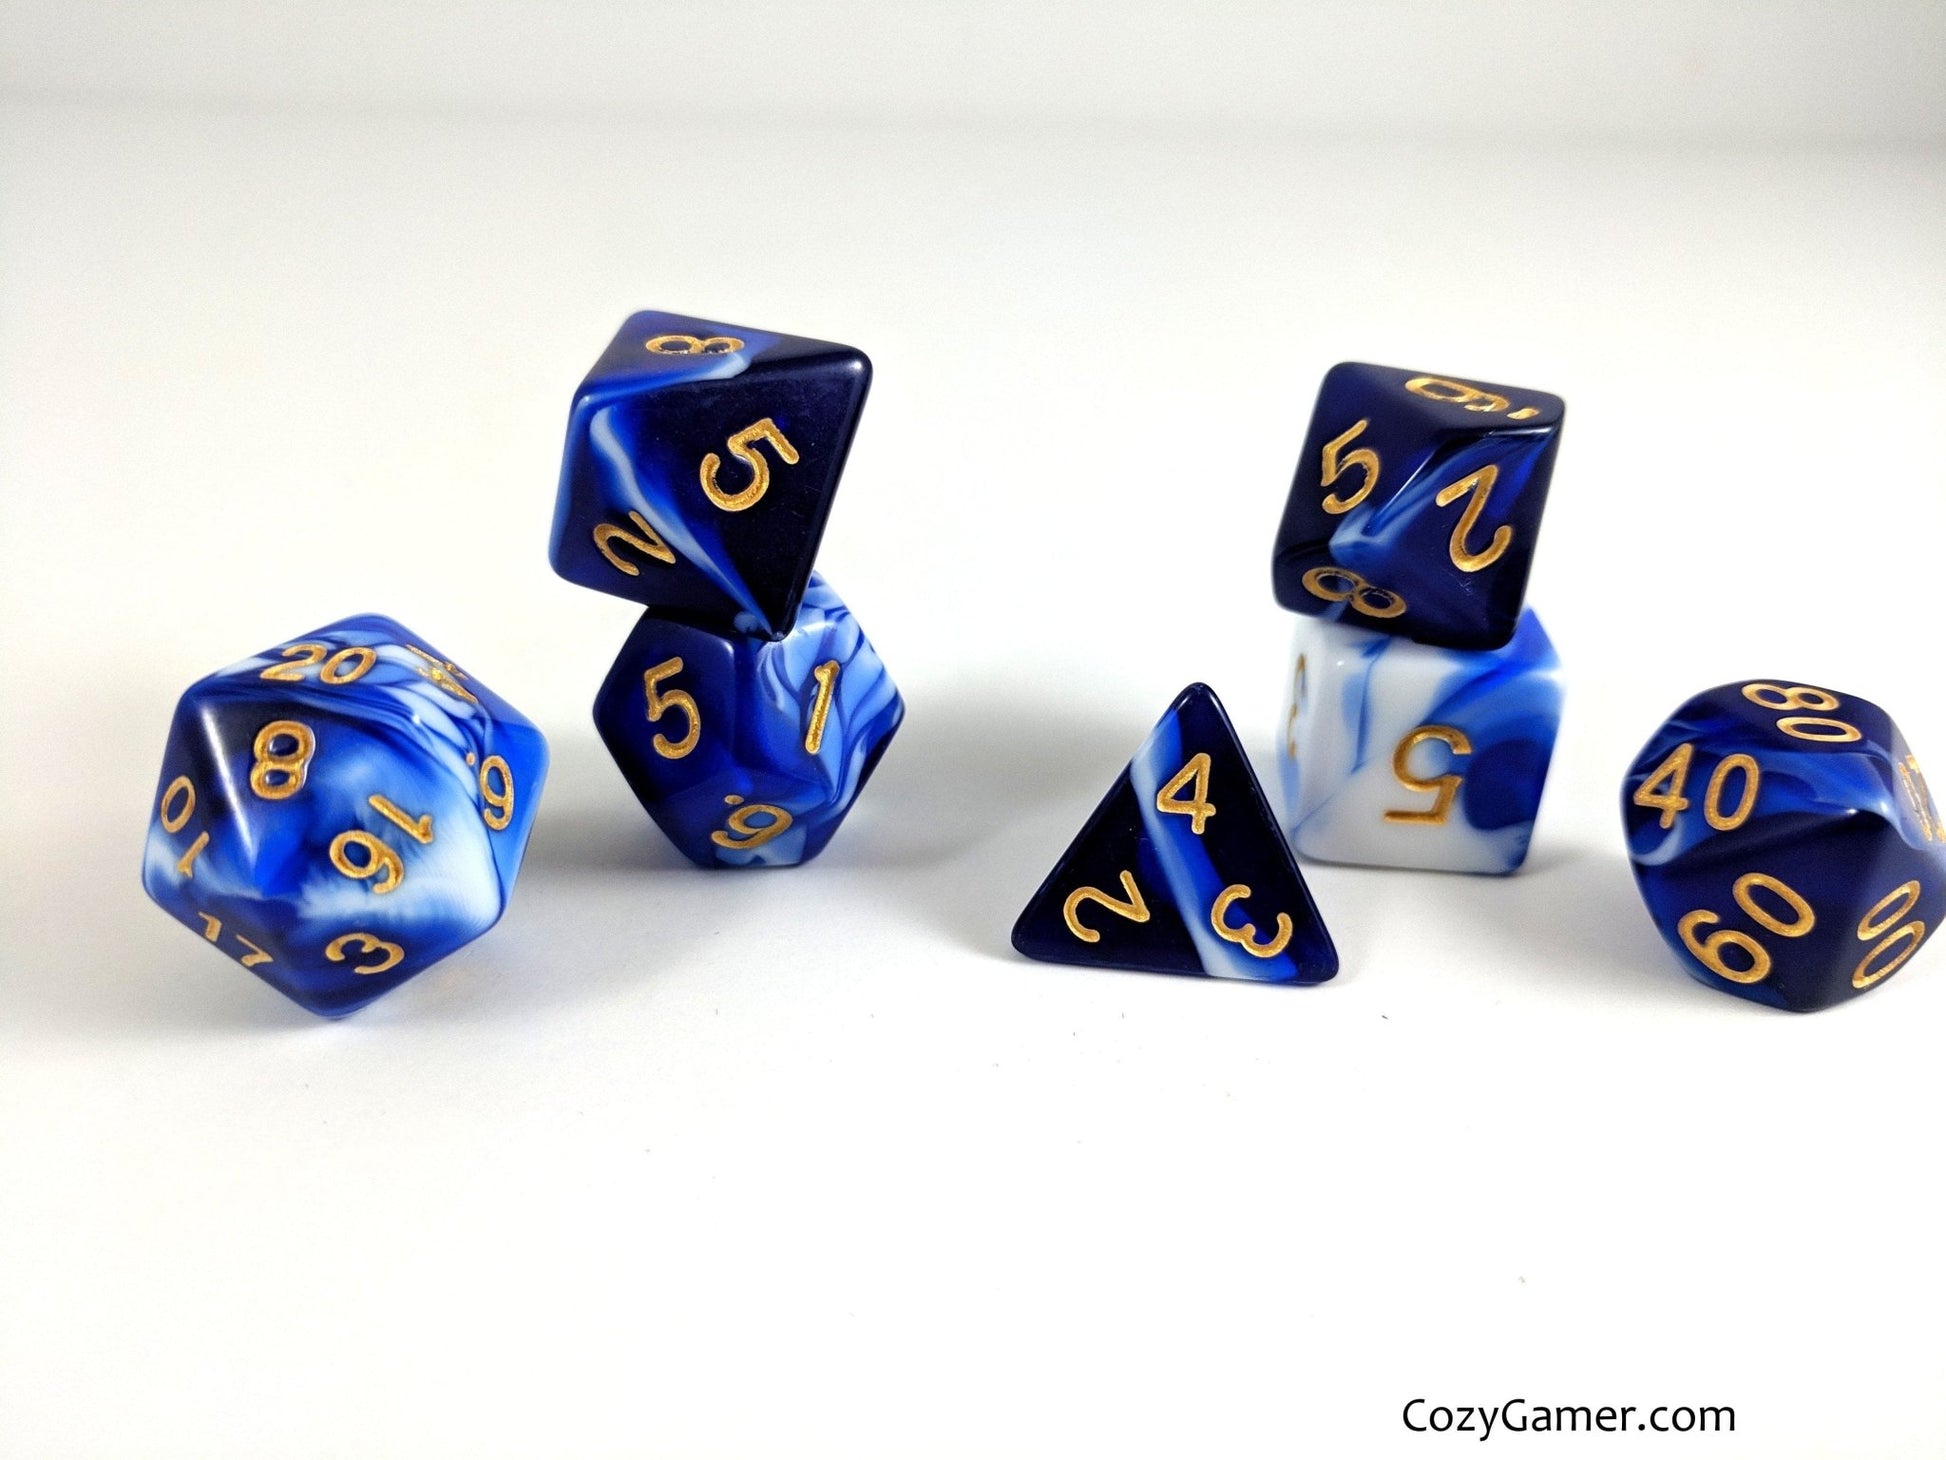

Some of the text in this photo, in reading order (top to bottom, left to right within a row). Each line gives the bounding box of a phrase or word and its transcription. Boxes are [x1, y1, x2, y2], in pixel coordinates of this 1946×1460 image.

[646, 335, 744, 354] 8
[699, 418, 799, 511] 5
[1321, 420, 1380, 514] 5
[593, 511, 676, 576] 2
[1436, 465, 1512, 572] 2
[1302, 567, 1406, 619] 8
[260, 644, 377, 684] 20
[644, 657, 700, 759] 5
[804, 661, 840, 754] 1
[1742, 683, 1862, 742] 80
[250, 720, 316, 799] 8
[1157, 753, 1216, 834] 4
[1383, 725, 1472, 825] 5
[1634, 743, 1759, 831] 40
[161, 776, 209, 877] 10
[329, 795, 434, 893] 16
[198, 911, 274, 967] 17
[1063, 870, 1150, 943] 2
[1211, 884, 1293, 957] 3
[1678, 872, 1815, 984] 60
[1852, 880, 1926, 989] 00
[325, 933, 404, 974] 3
